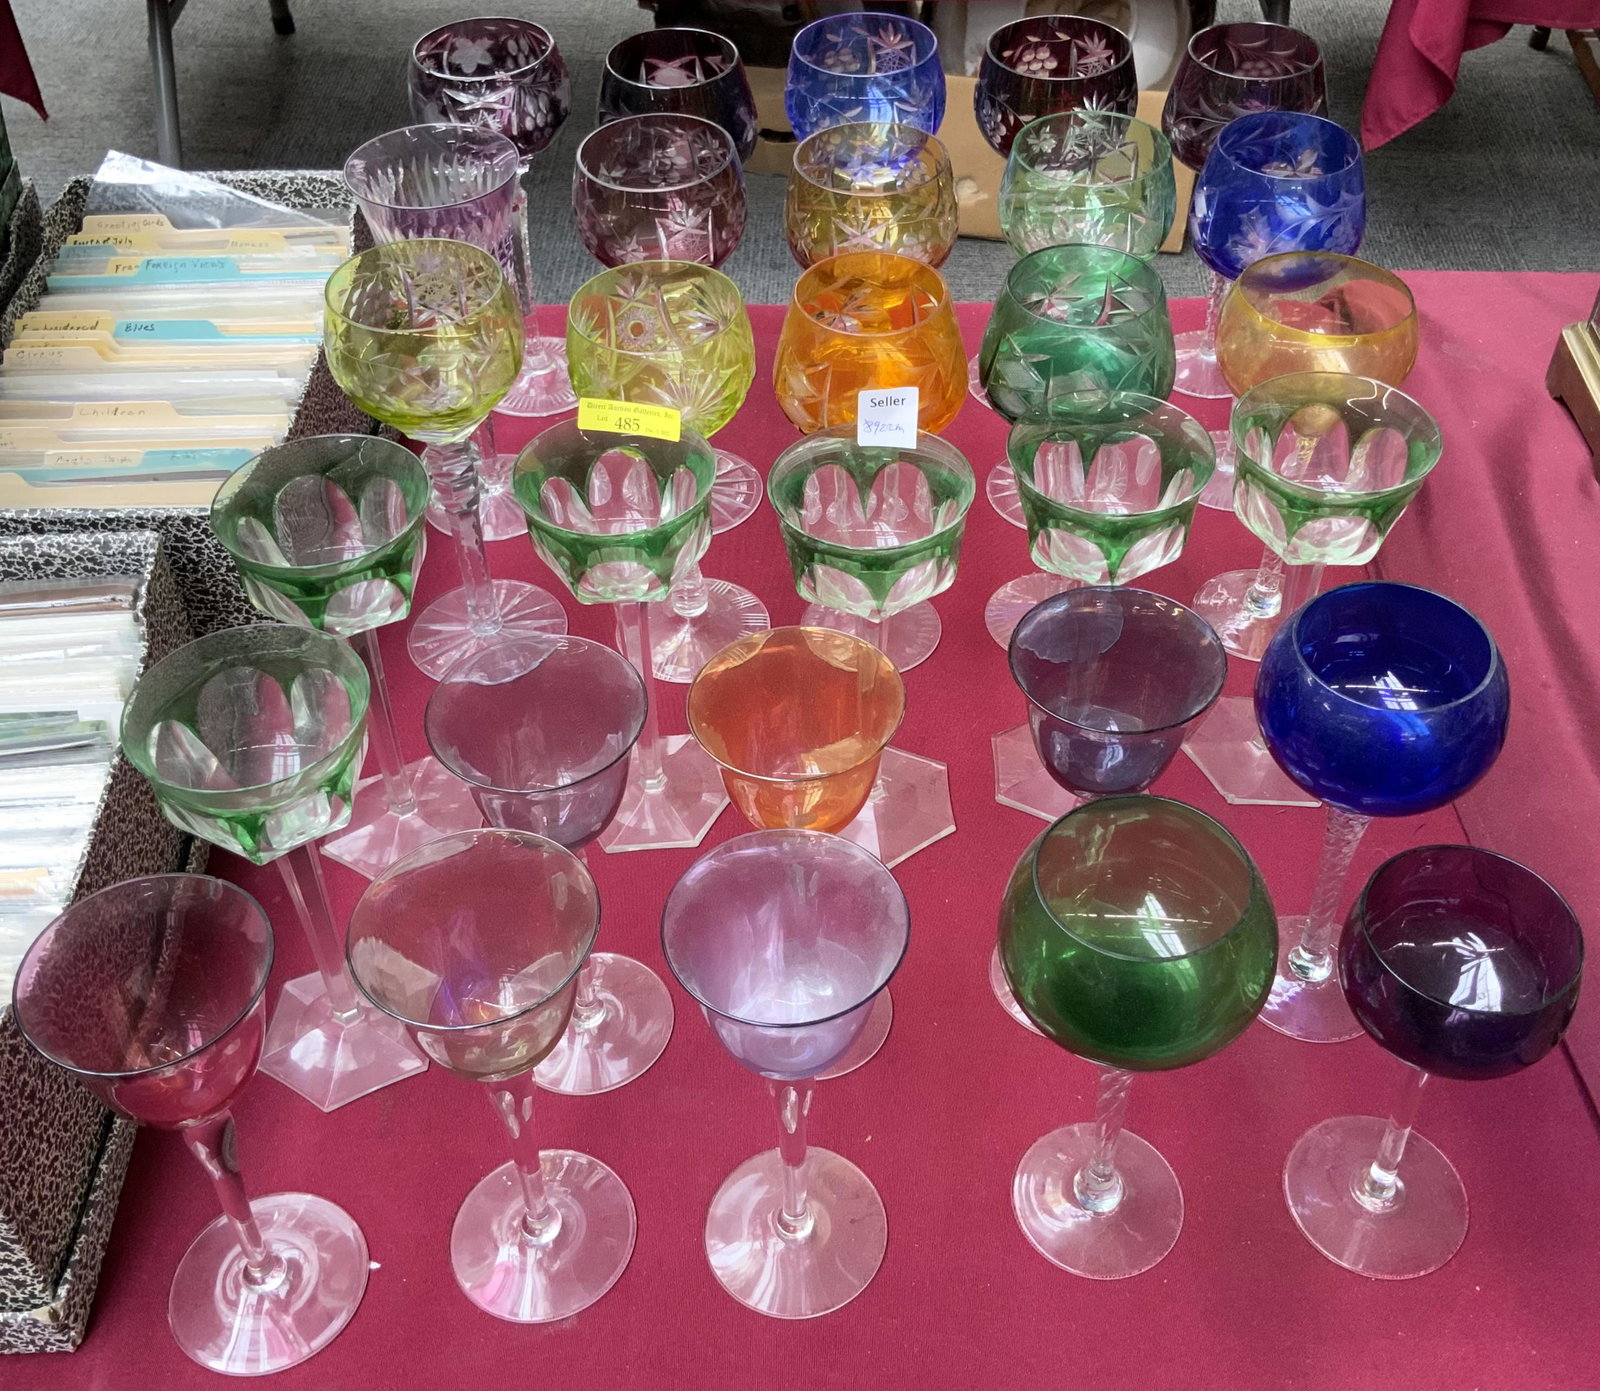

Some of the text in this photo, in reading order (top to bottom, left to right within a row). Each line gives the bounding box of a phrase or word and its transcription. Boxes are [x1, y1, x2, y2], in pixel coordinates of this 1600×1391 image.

[112, 236, 133, 247] July
[870, 395, 907, 408] Seller
[79, 406, 146, 416] Children
[614, 417, 640, 432] 485
